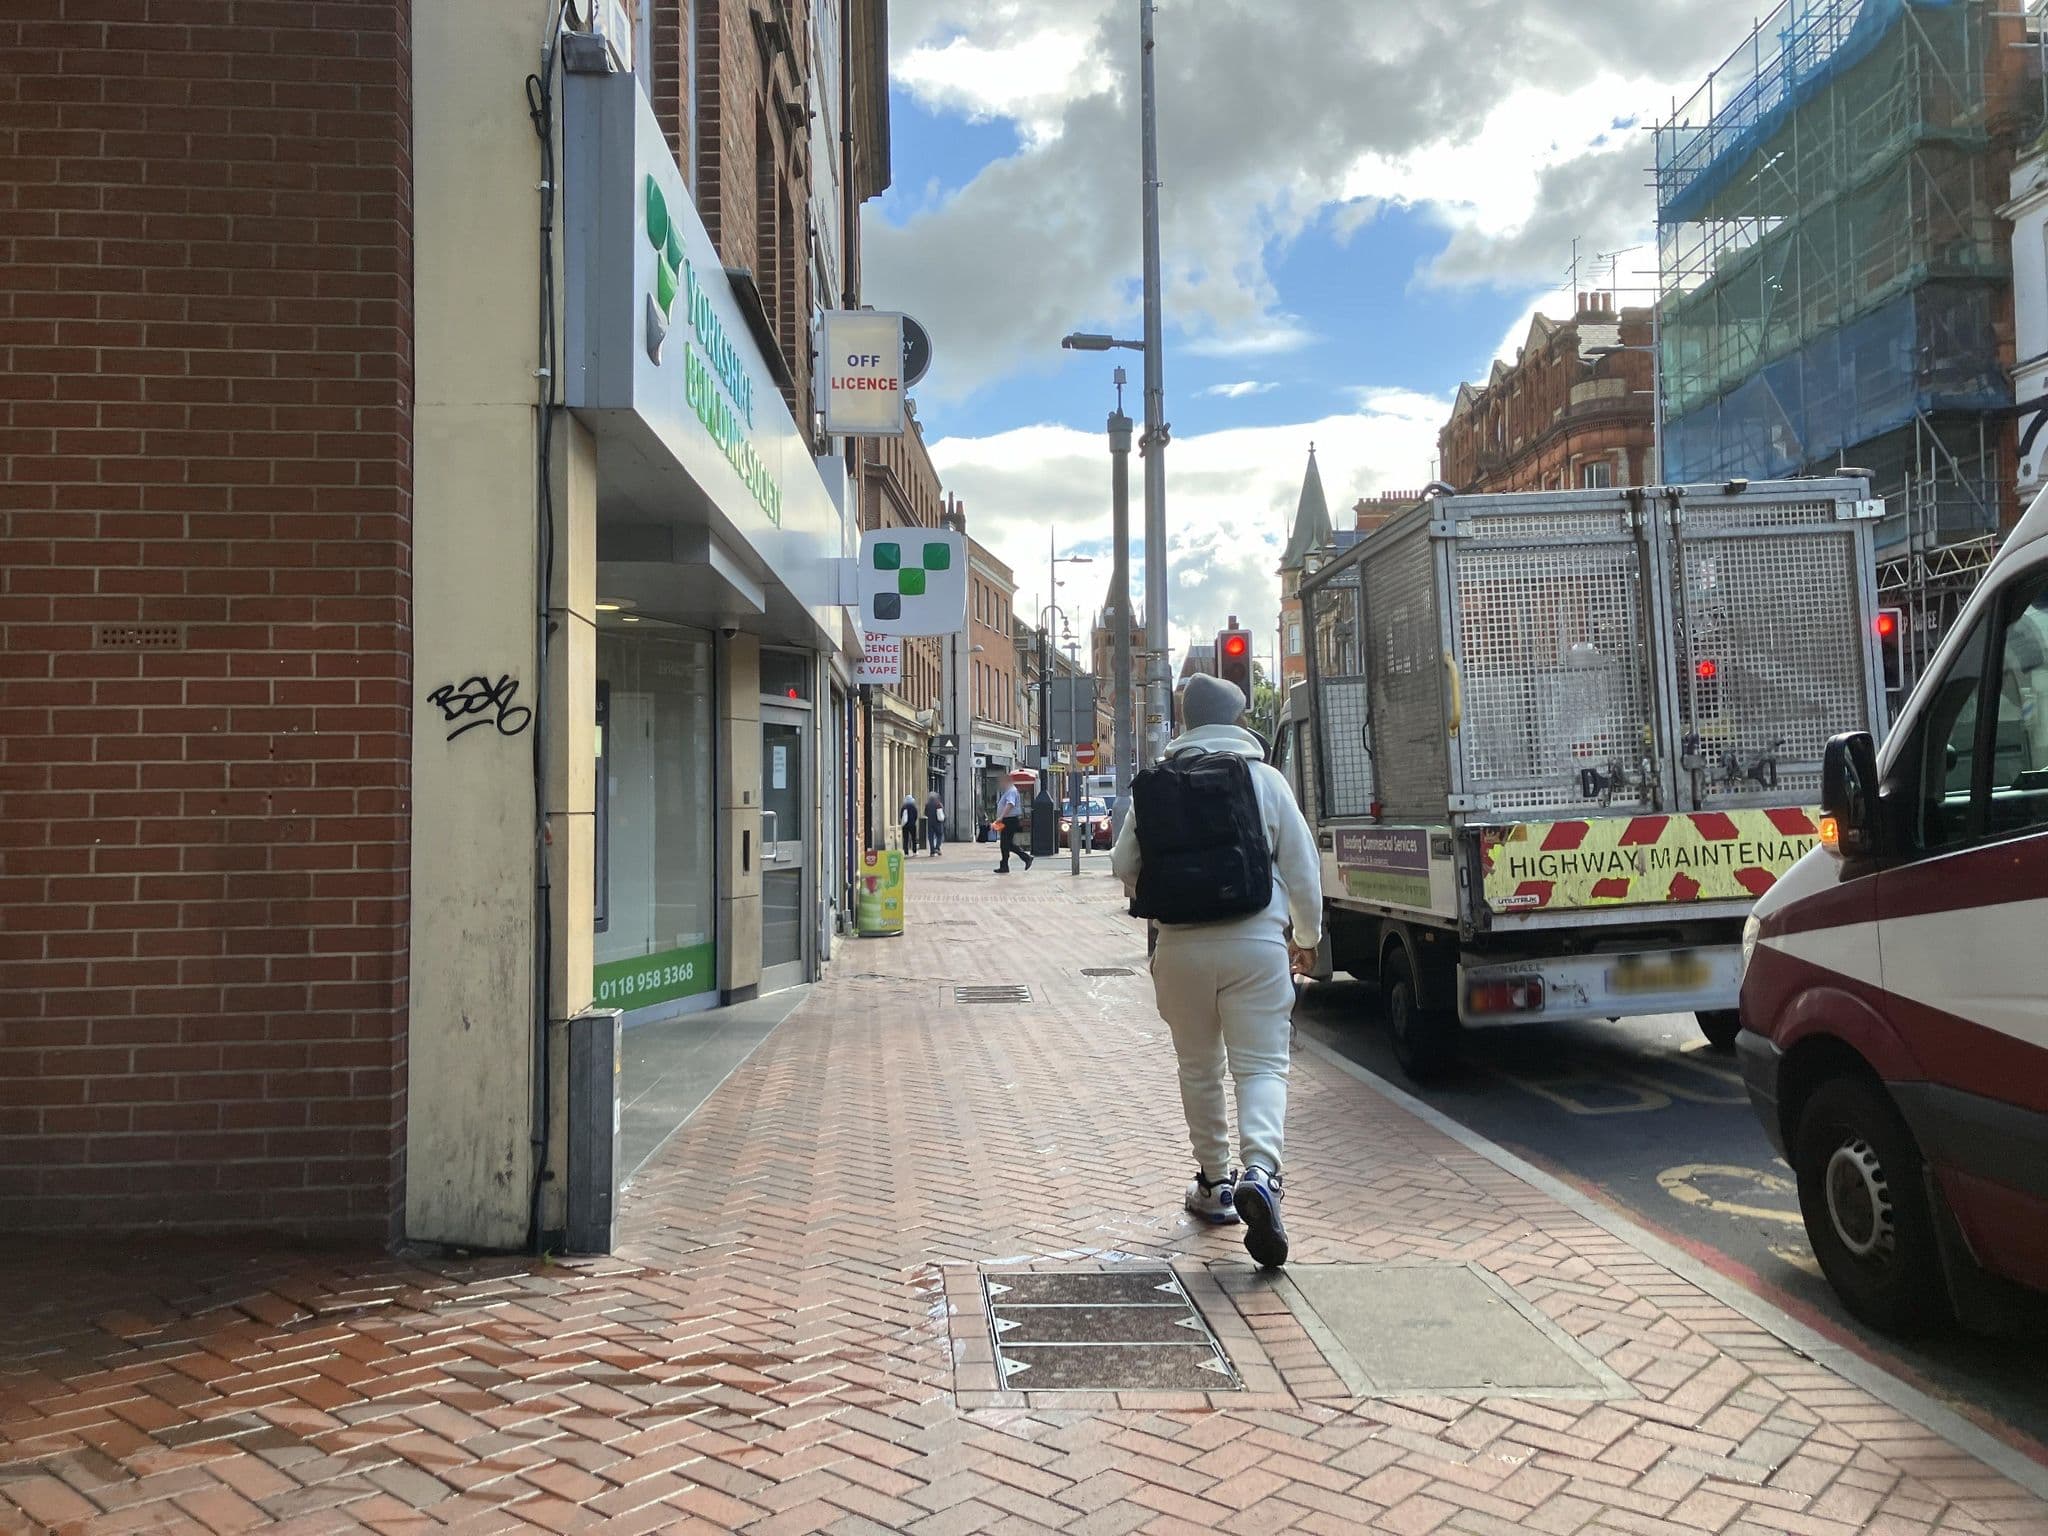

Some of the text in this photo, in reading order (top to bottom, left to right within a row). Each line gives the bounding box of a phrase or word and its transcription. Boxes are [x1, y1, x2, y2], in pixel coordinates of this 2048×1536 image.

[686, 258, 754, 430] YORKSHIRE
[847, 354, 881, 368] OFF
[831, 377, 898, 391] LICENCE
[684, 341, 783, 530] BUILDING SOCIETY
[865, 633, 887, 642] OFF
[865, 644, 899, 653] CENCE
[869, 666, 897, 675] VAPE
[1362, 835, 1394, 852] Commercial
[1393, 836, 1418, 853] Services
[1510, 838, 1821, 879] HIGHWAY MAINTENAN
[600, 962, 694, 1001] 0118 958 3368
